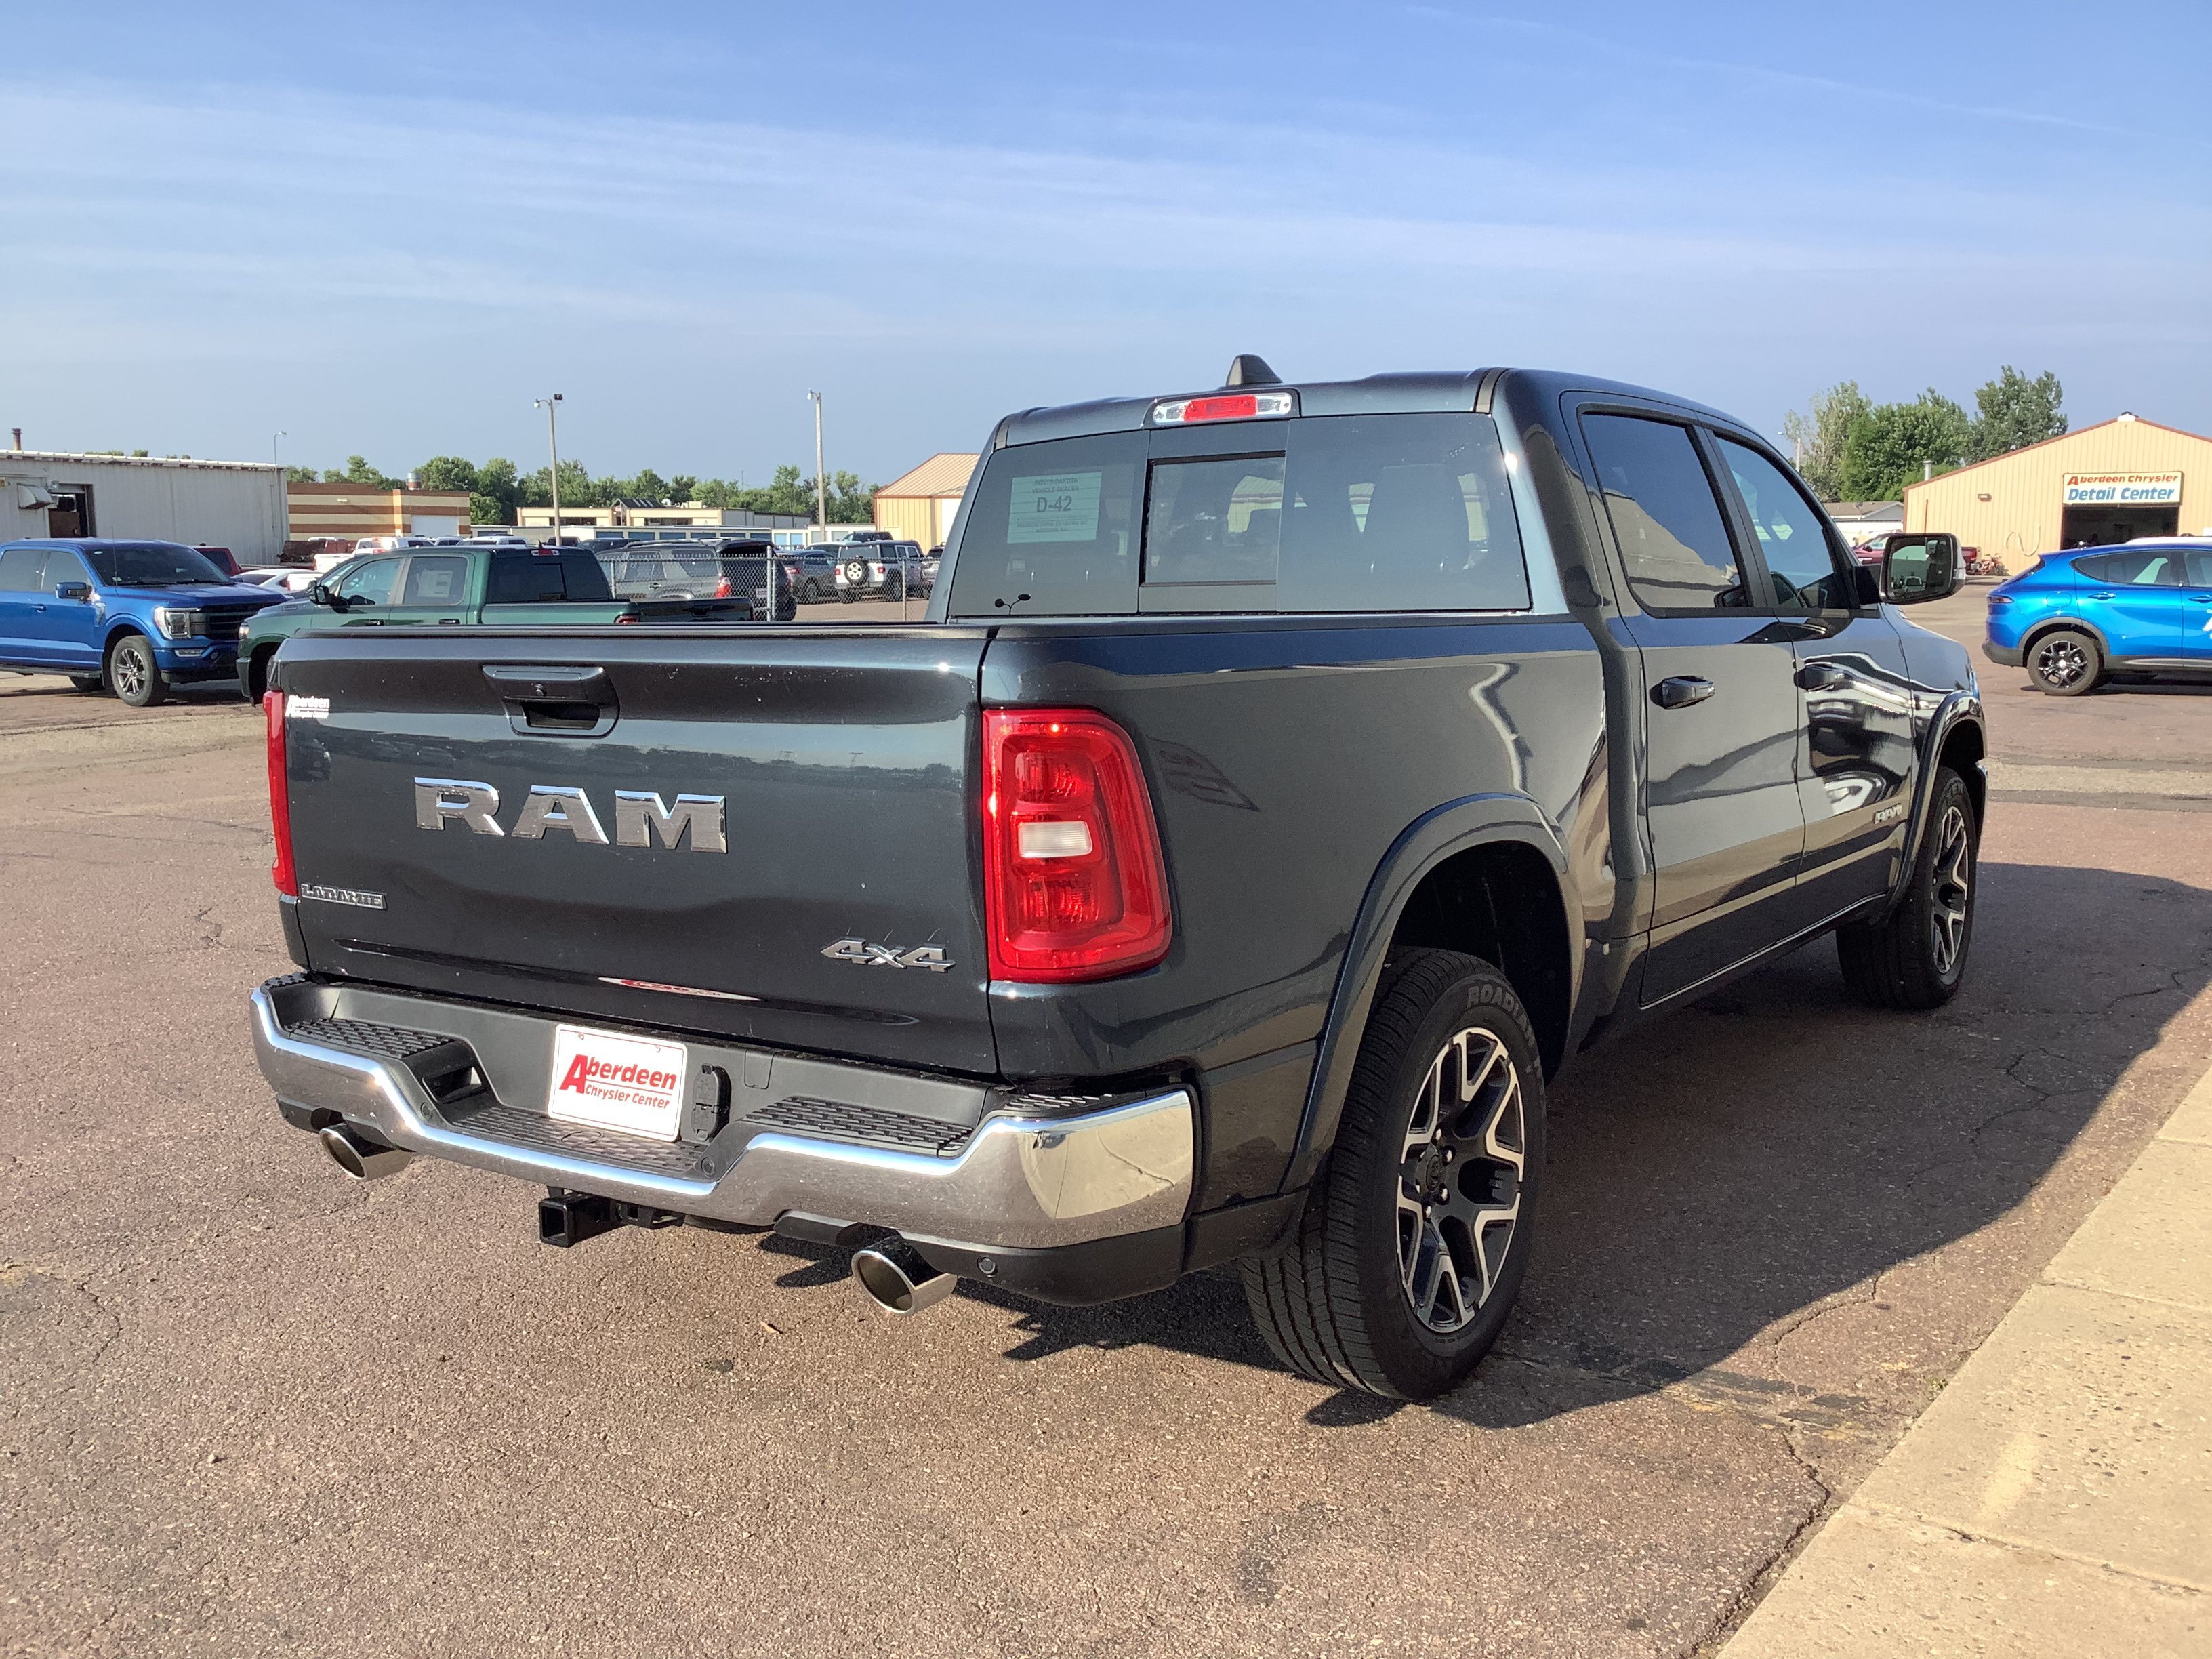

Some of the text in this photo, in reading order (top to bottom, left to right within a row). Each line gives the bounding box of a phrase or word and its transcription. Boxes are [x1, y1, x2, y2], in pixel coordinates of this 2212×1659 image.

[2067, 474, 2178, 486] Aberdeen Chrysler
[1036, 495, 1073, 513] D-42
[2068, 487, 2175, 501] Detail Center
[414, 777, 728, 854] RAM
[1873, 803, 1903, 825] RAM
[559, 1054, 677, 1094] Aberdeen
[585, 1084, 670, 1109] Chrysler Center
